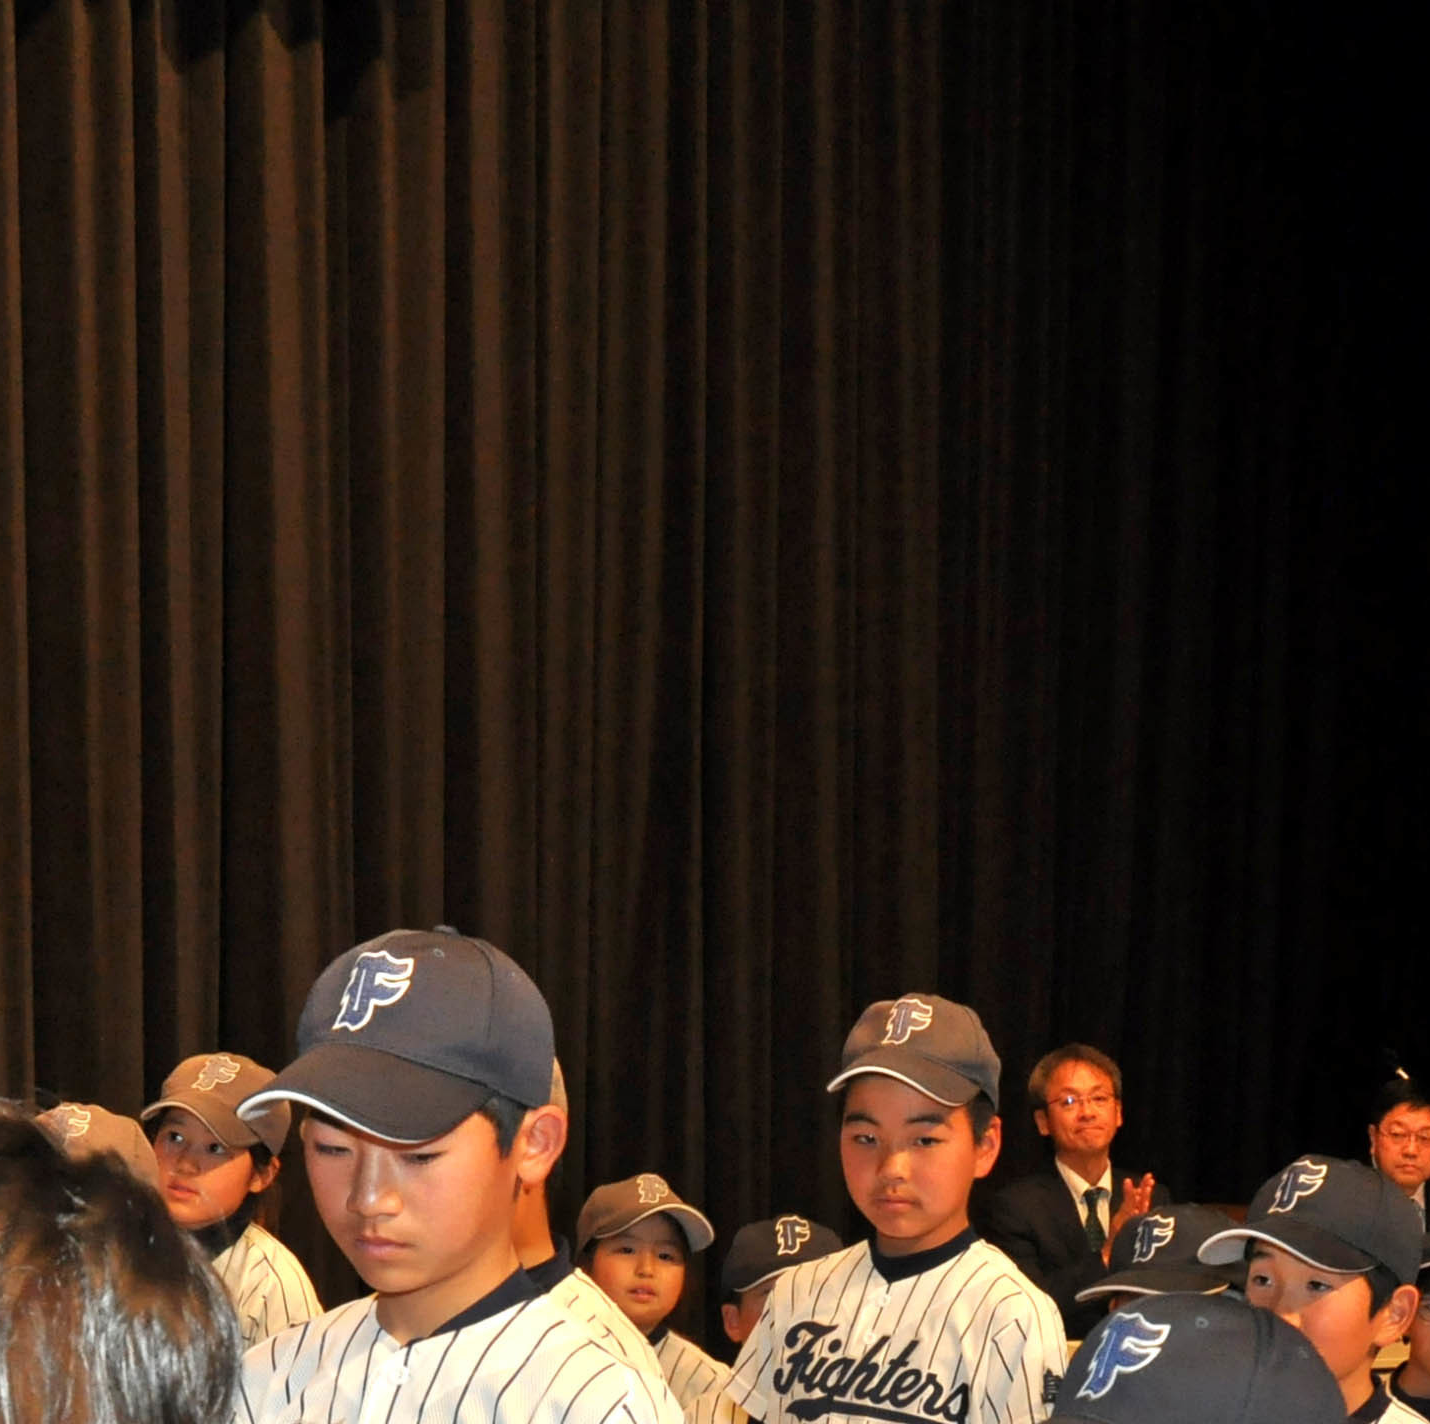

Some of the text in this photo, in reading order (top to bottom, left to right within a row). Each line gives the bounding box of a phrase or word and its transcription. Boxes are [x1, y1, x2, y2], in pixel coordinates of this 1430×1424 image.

[332, 950, 415, 1032] F
[881, 999, 933, 1046] F
[191, 1055, 241, 1091] F
[637, 1173, 669, 1204] F
[1268, 1160, 1328, 1214] F
[776, 1215, 811, 1255] F
[1133, 1214, 1176, 1263] F
[1075, 1312, 1171, 1399] F
